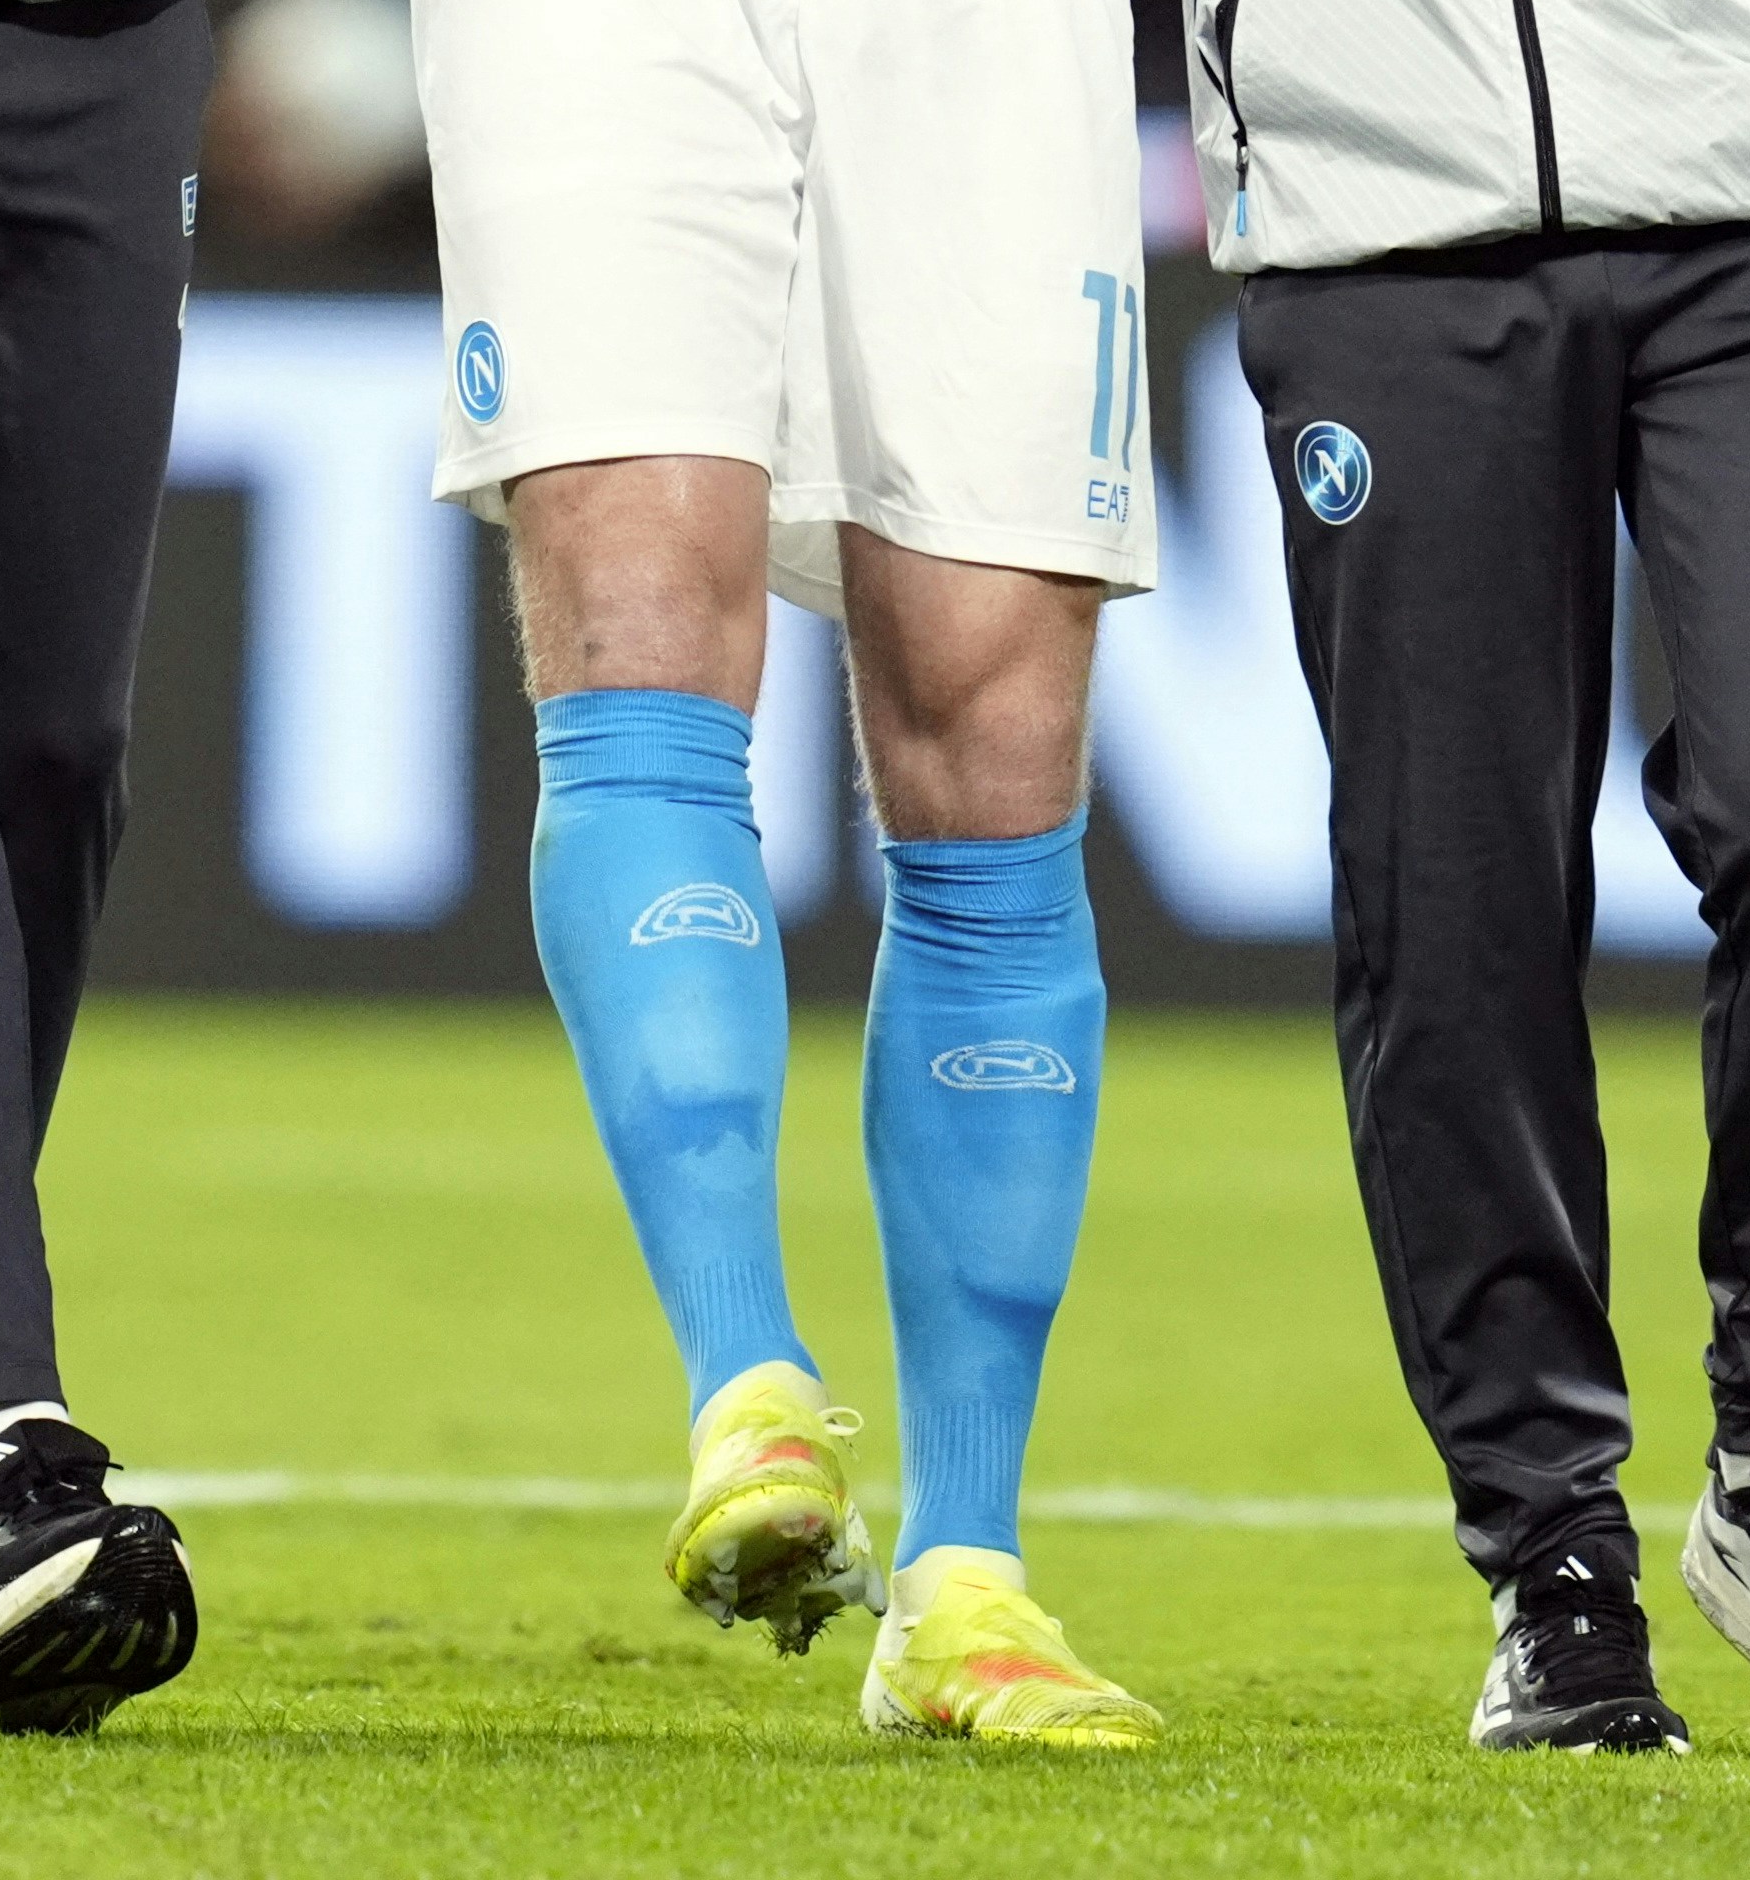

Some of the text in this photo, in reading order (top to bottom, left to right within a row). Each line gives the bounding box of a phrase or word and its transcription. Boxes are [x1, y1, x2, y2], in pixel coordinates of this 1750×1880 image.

[465, 346, 498, 398] N
[1082, 268, 1139, 473] 11
[1313, 448, 1348, 498] N
